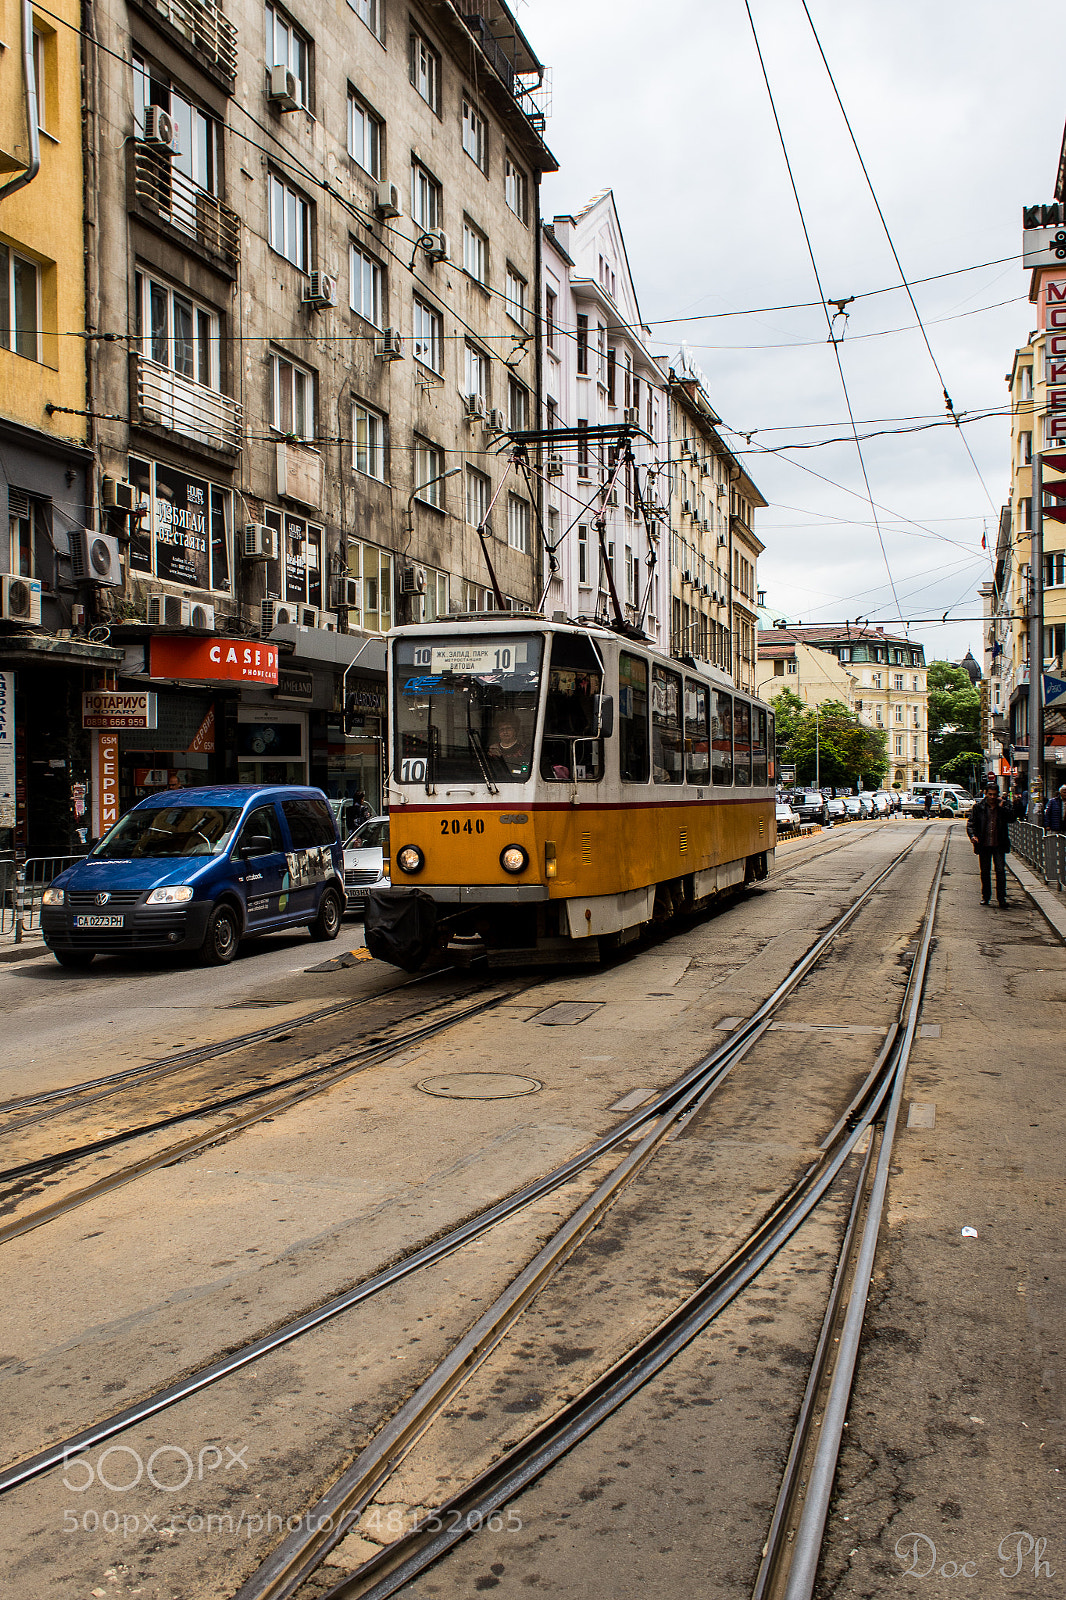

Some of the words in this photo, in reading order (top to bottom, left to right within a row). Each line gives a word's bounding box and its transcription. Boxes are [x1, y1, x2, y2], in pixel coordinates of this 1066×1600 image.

[1022, 202, 1066, 231] КИ
[158, 502, 206, 534] ИЗБЯГАЙ
[209, 645, 261, 666] CASE
[415, 648, 431, 664] 10
[494, 648, 511, 669] 10
[450, 662, 475, 670] ВИТОША
[85, 696, 147, 709] НОТАРИУС
[109, 718, 126, 726] 666
[128, 718, 144, 726] 959
[193, 711, 215, 751] СЕРВИЗ
[101, 736, 117, 744] GSM
[203, 741, 215, 750] GSM
[402, 760, 425, 782] 10
[440, 819, 485, 835] 2040
[78, 916, 89, 927] CA
[90, 916, 110, 927] 0273
[111, 916, 122, 927] PH
